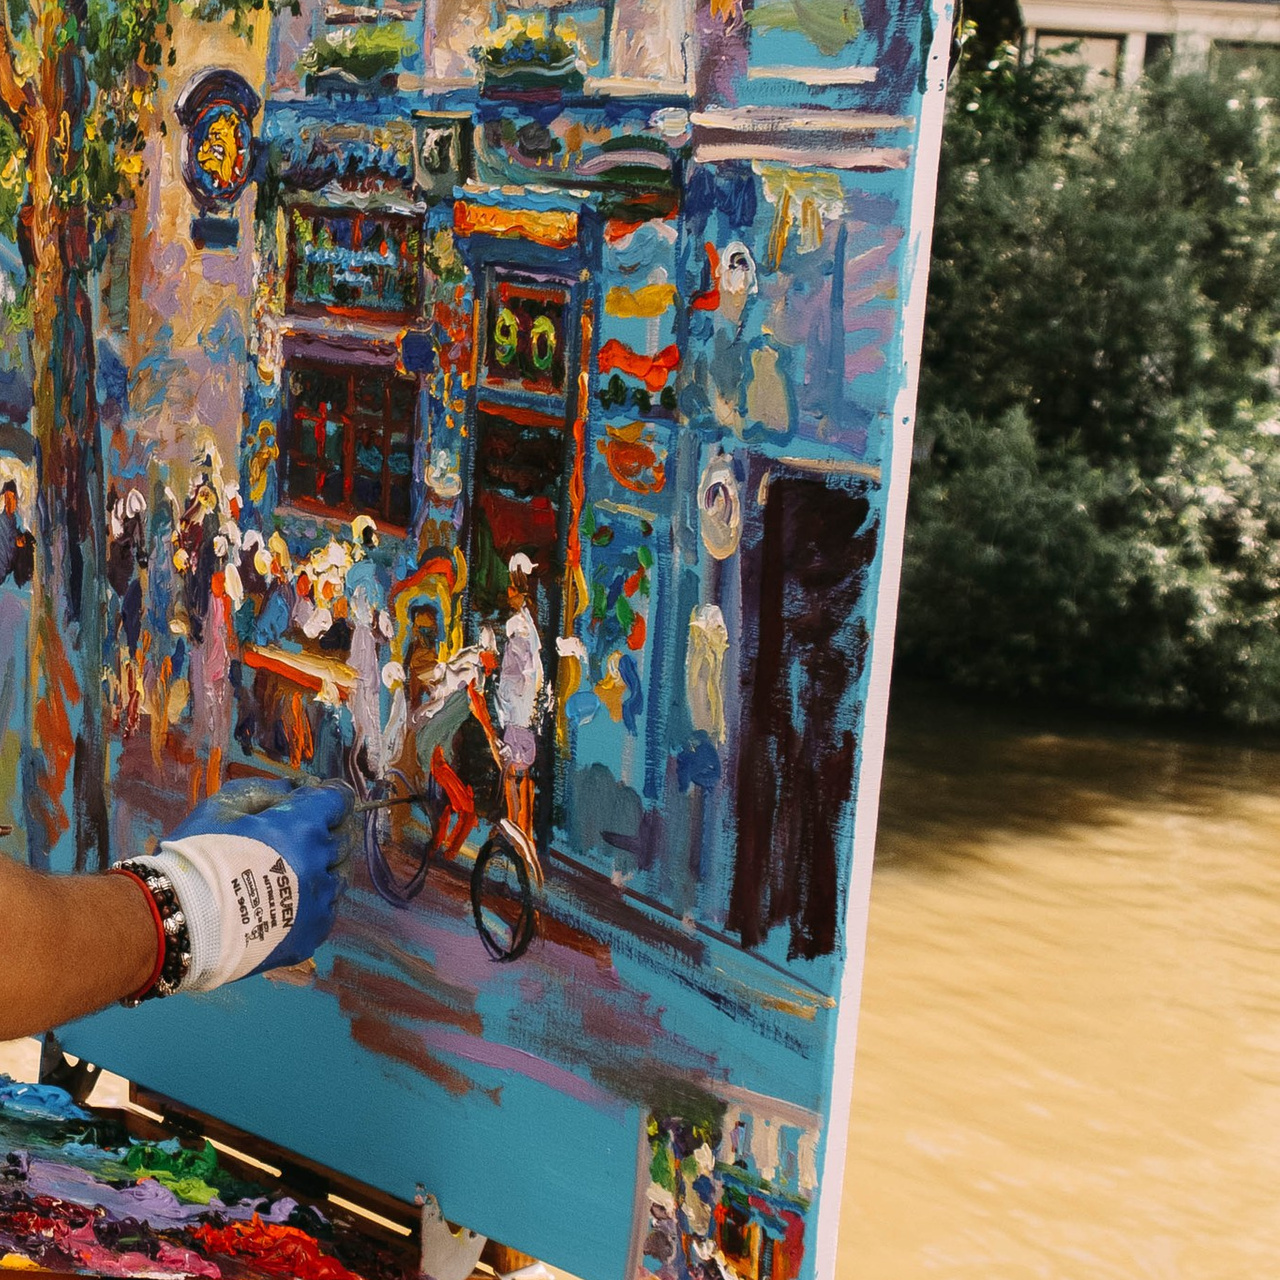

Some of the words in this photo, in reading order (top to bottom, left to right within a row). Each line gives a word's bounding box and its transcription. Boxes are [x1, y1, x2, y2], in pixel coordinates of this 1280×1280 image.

[494, 307, 557, 370] 90
[231, 878, 242, 896] NL
[237, 896, 250, 925] 9610
[262, 874, 276, 909] NITRILE
[276, 875, 295, 929] SEVEN
